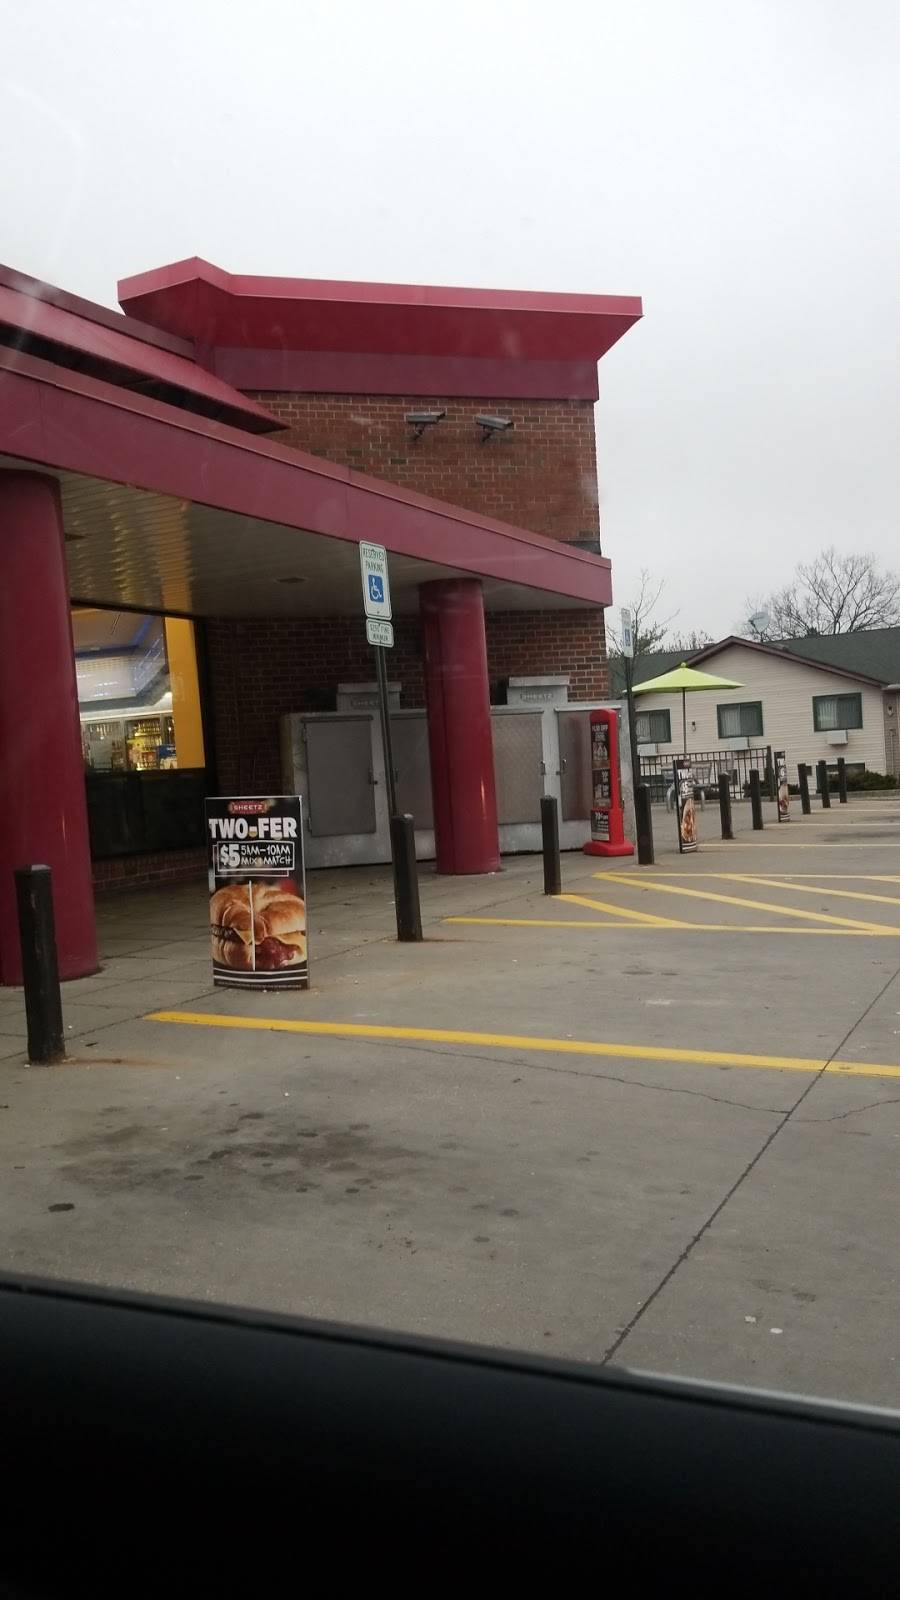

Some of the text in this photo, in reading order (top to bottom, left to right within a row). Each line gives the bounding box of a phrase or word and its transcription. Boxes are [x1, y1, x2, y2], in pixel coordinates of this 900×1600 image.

[363, 547, 385, 561] RESERVED
[365, 560, 384, 573] PARKING
[220, 844, 241, 868] $5
